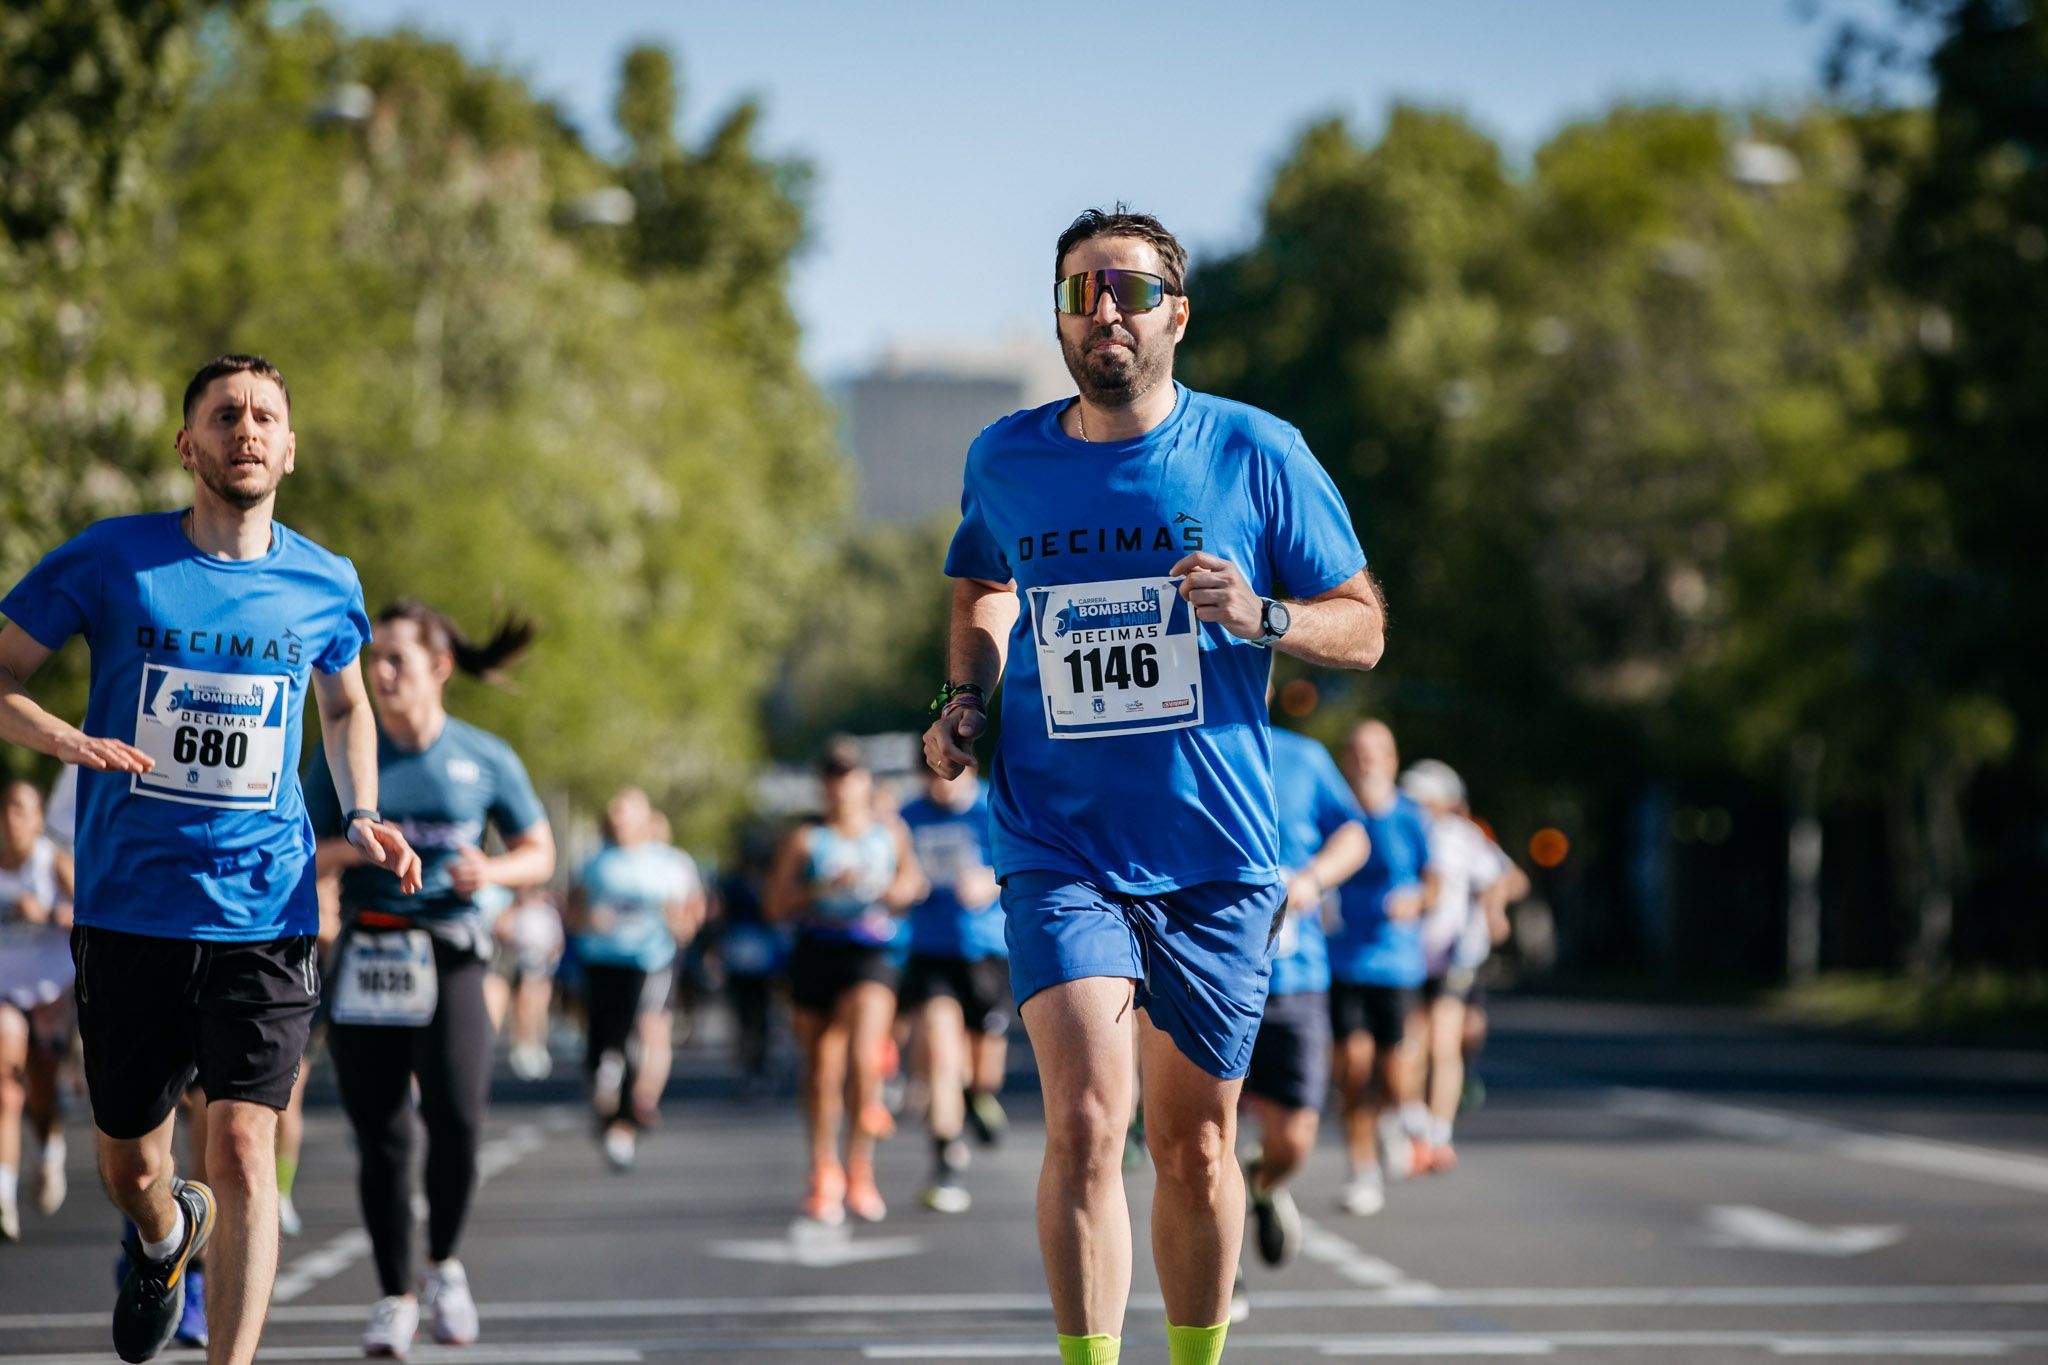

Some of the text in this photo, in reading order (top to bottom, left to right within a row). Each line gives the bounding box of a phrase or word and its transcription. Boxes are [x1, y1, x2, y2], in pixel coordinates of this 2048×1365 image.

[1019, 527, 1203, 561] DECIMAS
[1078, 597, 1107, 605] CARRERA
[1079, 600, 1157, 618] BOMBEROS
[1072, 626, 1158, 644] DECIMAS
[136, 626, 302, 664] DECIMAS
[1063, 643, 1159, 693] 1146
[192, 690, 261, 706] BOMBEROS
[182, 711, 257, 728] DECIMAS
[173, 725, 248, 768] 680
